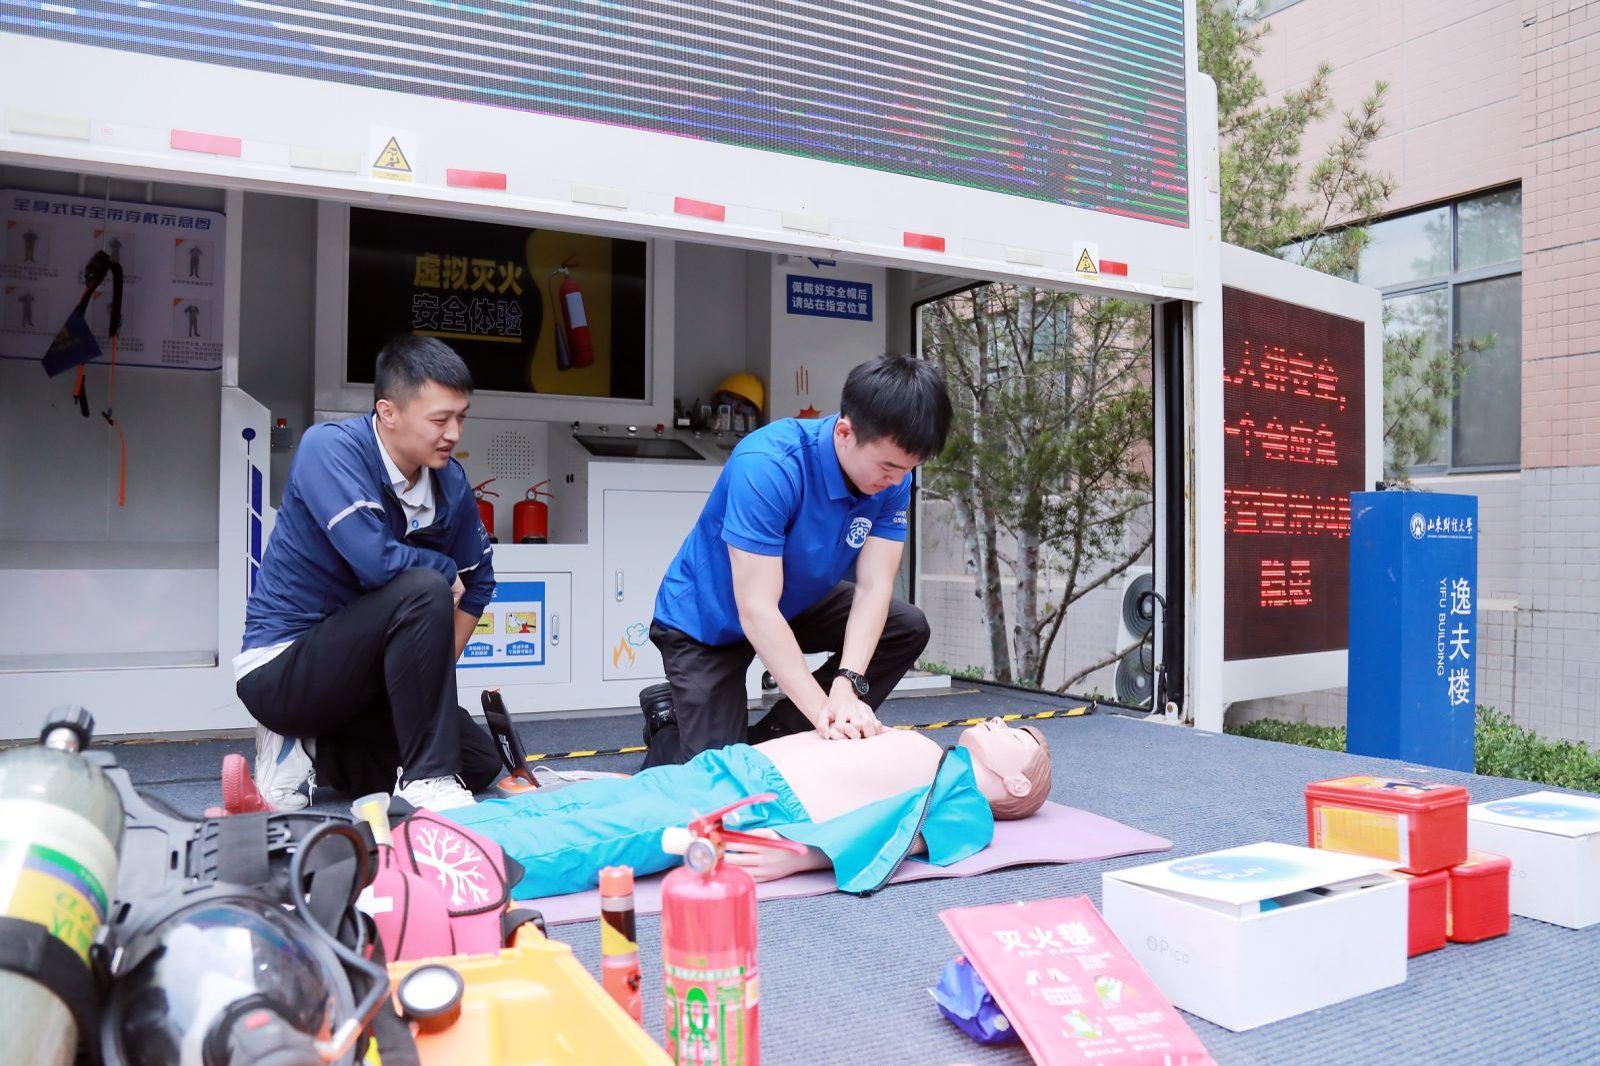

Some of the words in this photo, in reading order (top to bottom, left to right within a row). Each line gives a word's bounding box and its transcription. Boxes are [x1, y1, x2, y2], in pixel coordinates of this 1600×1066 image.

[12, 198, 212, 231] 全身式安全带穿戴示意图
[413, 252, 524, 296] 虚拟灭火
[792, 281, 867, 301] 佩戴好安全帽后
[412, 293, 522, 336] 安全体验
[792, 296, 868, 316] 请站在指定位置
[1224, 411, 1338, 466] 个会应急
[1439, 577, 1447, 608] YIFU
[1437, 613, 1446, 676] BUILDING
[1448, 577, 1471, 706] 逸夫楼
